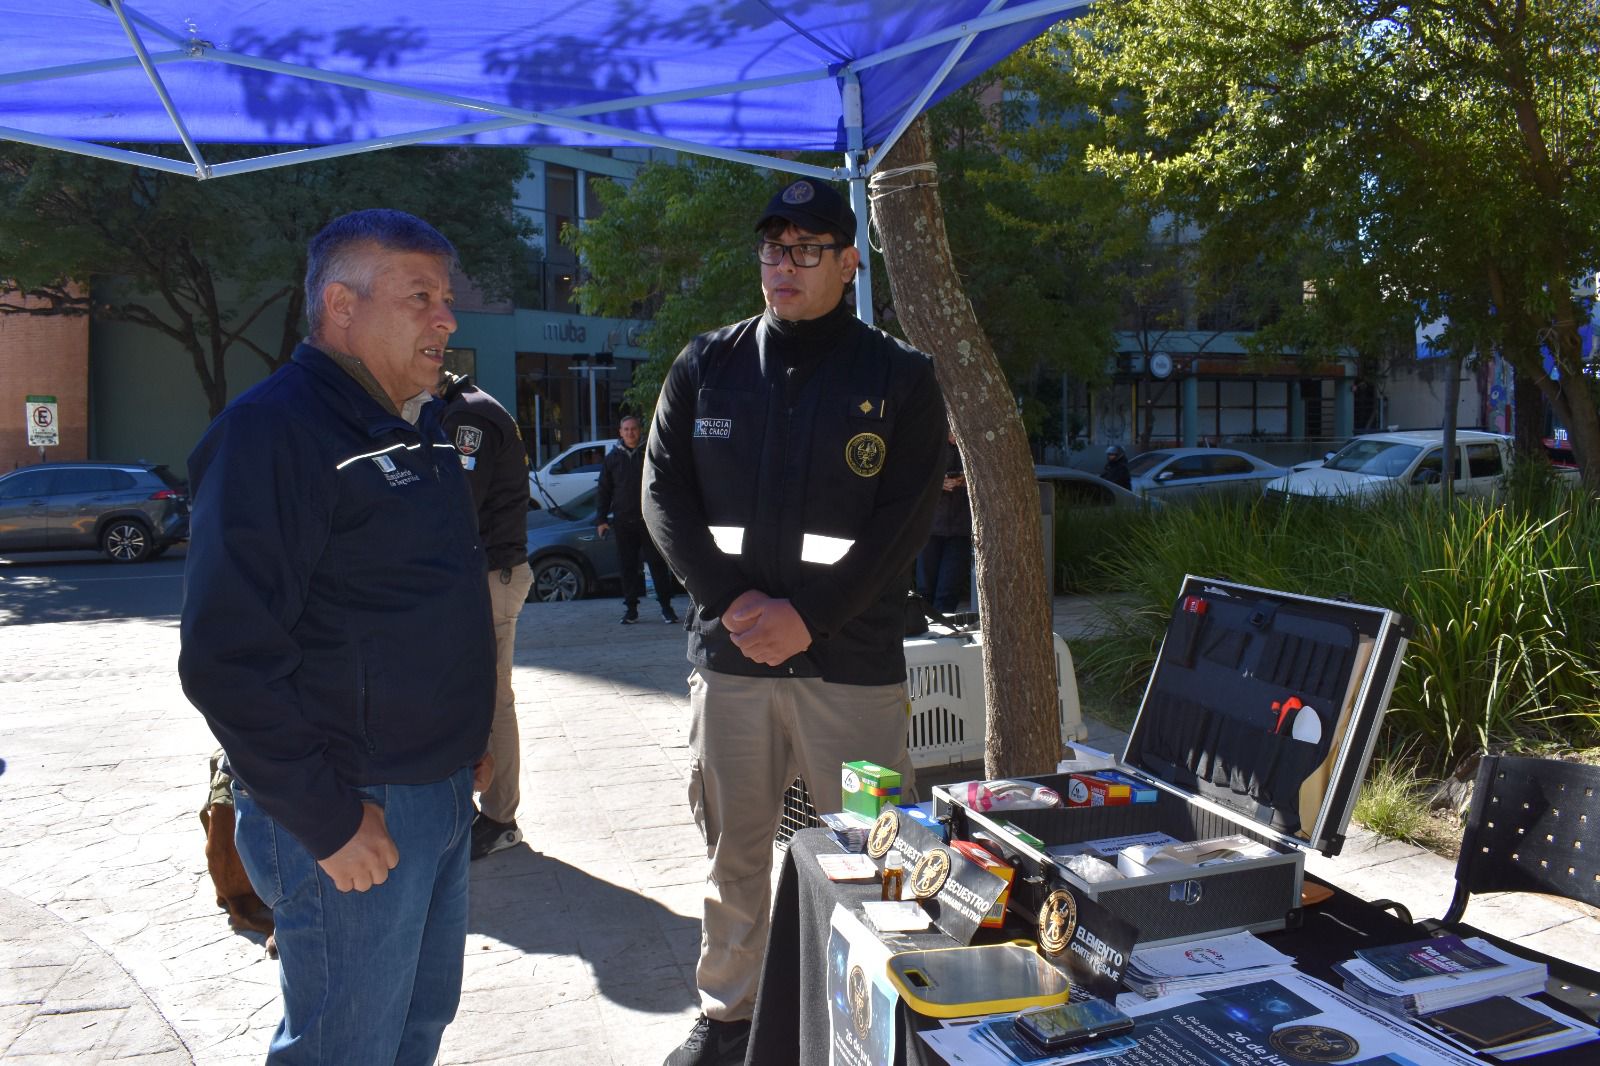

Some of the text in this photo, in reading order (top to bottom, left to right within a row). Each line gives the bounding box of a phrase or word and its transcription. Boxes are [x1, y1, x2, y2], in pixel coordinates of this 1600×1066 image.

[545, 320, 586, 343] muba
[38, 410, 48, 424] E
[701, 420, 729, 428] POLICIA
[709, 428, 728, 436] CHACO
[893, 836, 922, 862] SECUEST
[944, 878, 990, 912] SECUESTRO
[960, 904, 982, 924] SATIVA
[1071, 942, 1093, 961] CORTE
[1076, 925, 1123, 967] ELEMENTO
[1147, 1034, 1161, 1043] son
[1172, 1015, 1186, 1025] Uso
[1185, 1024, 1216, 1045] Indebido
[1187, 1016, 1200, 1025] Día
[1199, 1024, 1244, 1054] Internacional
[1227, 1031, 1291, 1066] 26 de jun
